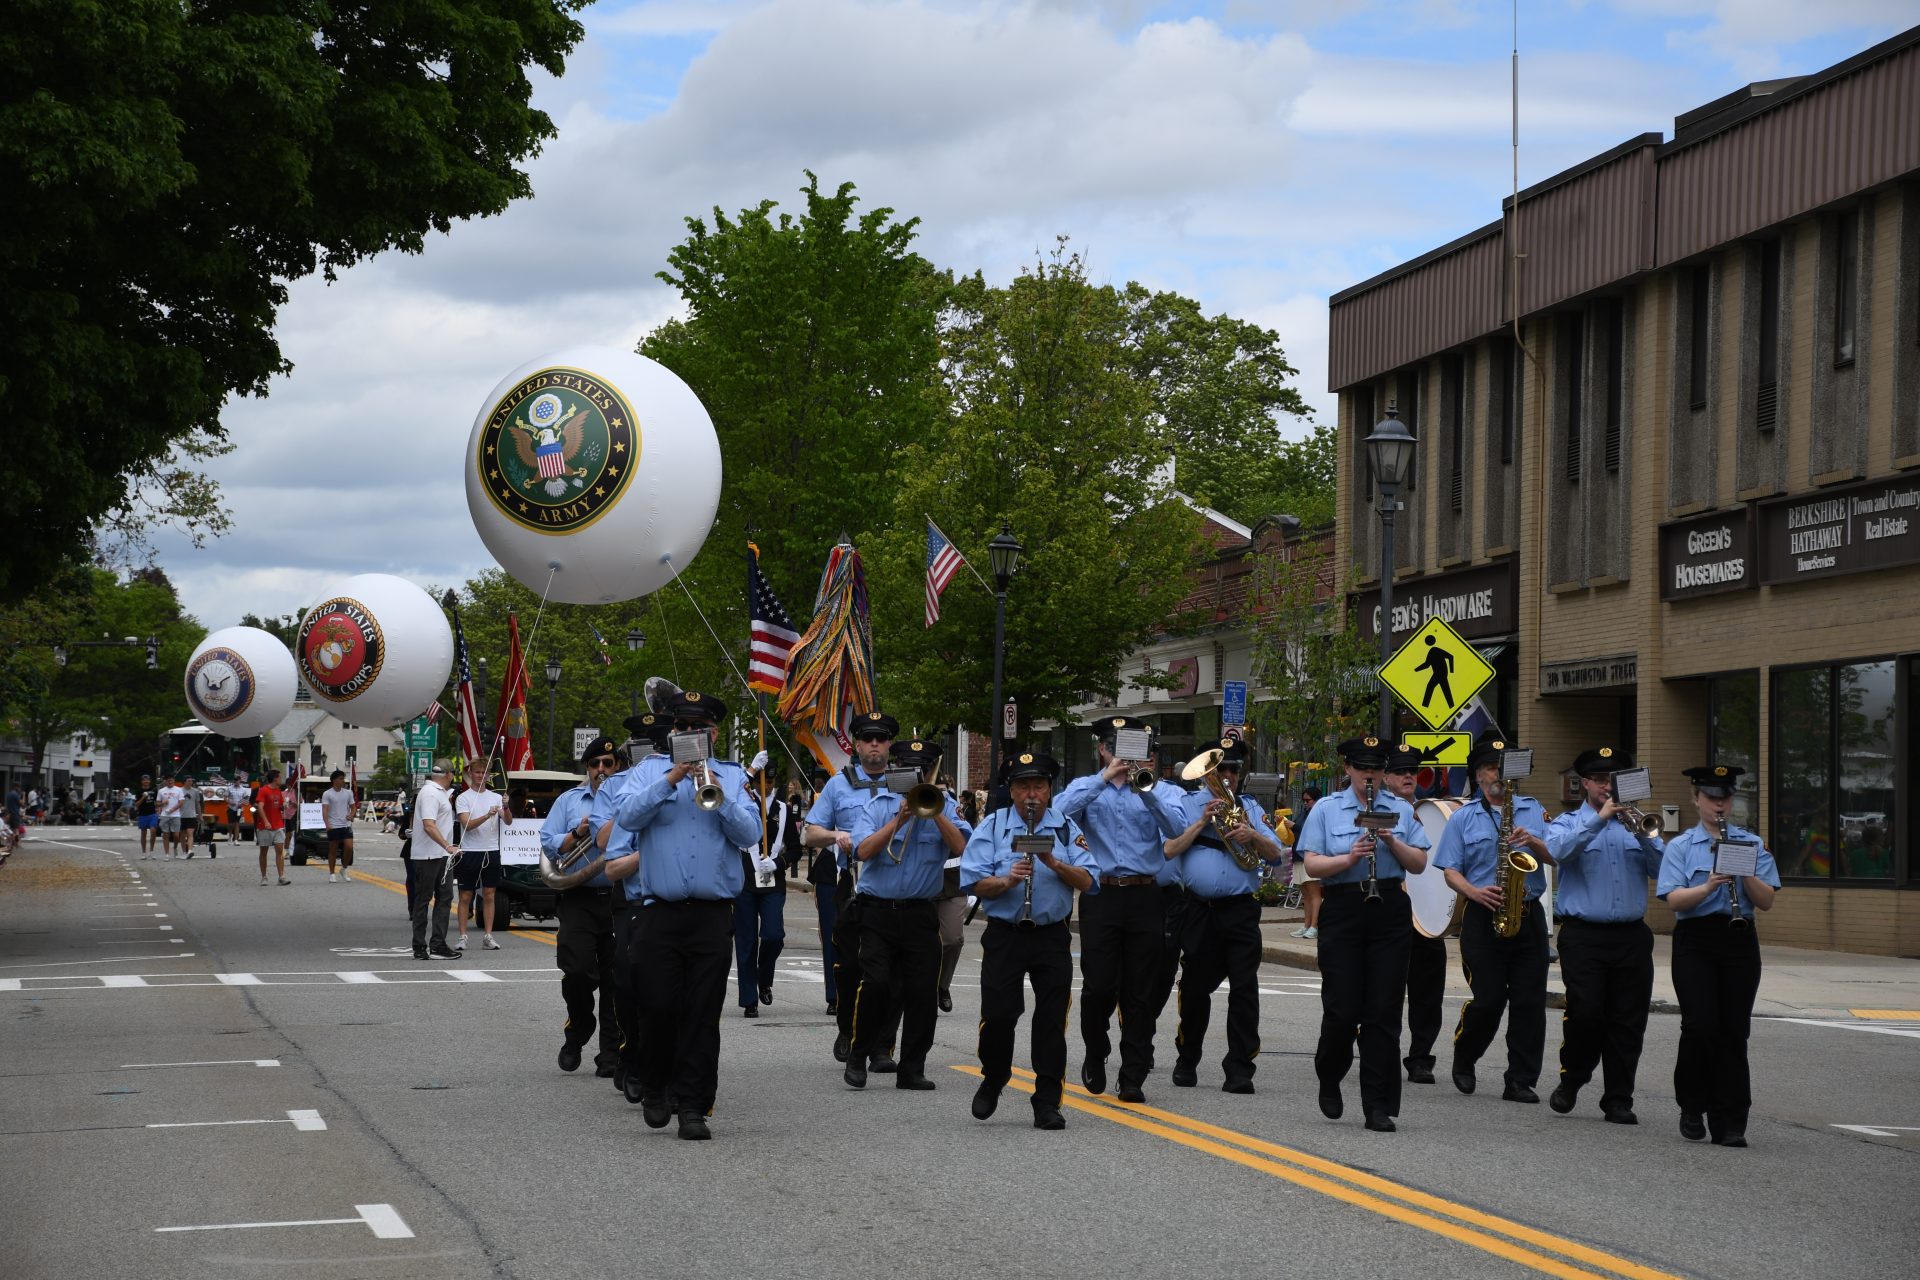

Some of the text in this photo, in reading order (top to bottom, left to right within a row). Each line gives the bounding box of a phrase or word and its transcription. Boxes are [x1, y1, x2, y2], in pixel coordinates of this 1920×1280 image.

[492, 374, 613, 430] UNITED STATES
[539, 498, 591, 522] ARMY
[1788, 498, 1846, 529] BERKSHIRE
[1852, 496, 1874, 515] Town
[1874, 490, 1889, 512] and
[1688, 526, 1732, 555] GREEN'S
[1791, 525, 1843, 555] HATHAWAY
[1865, 517, 1908, 540] Real Estate
[1675, 559, 1744, 588] HOUSEWARES
[302, 603, 376, 643] UNITED STATES
[1372, 588, 1493, 634] GEEN'S HARDWARE
[191, 653, 248, 681] UNITED STATES
[300, 658, 373, 696] MARINE CORPS
